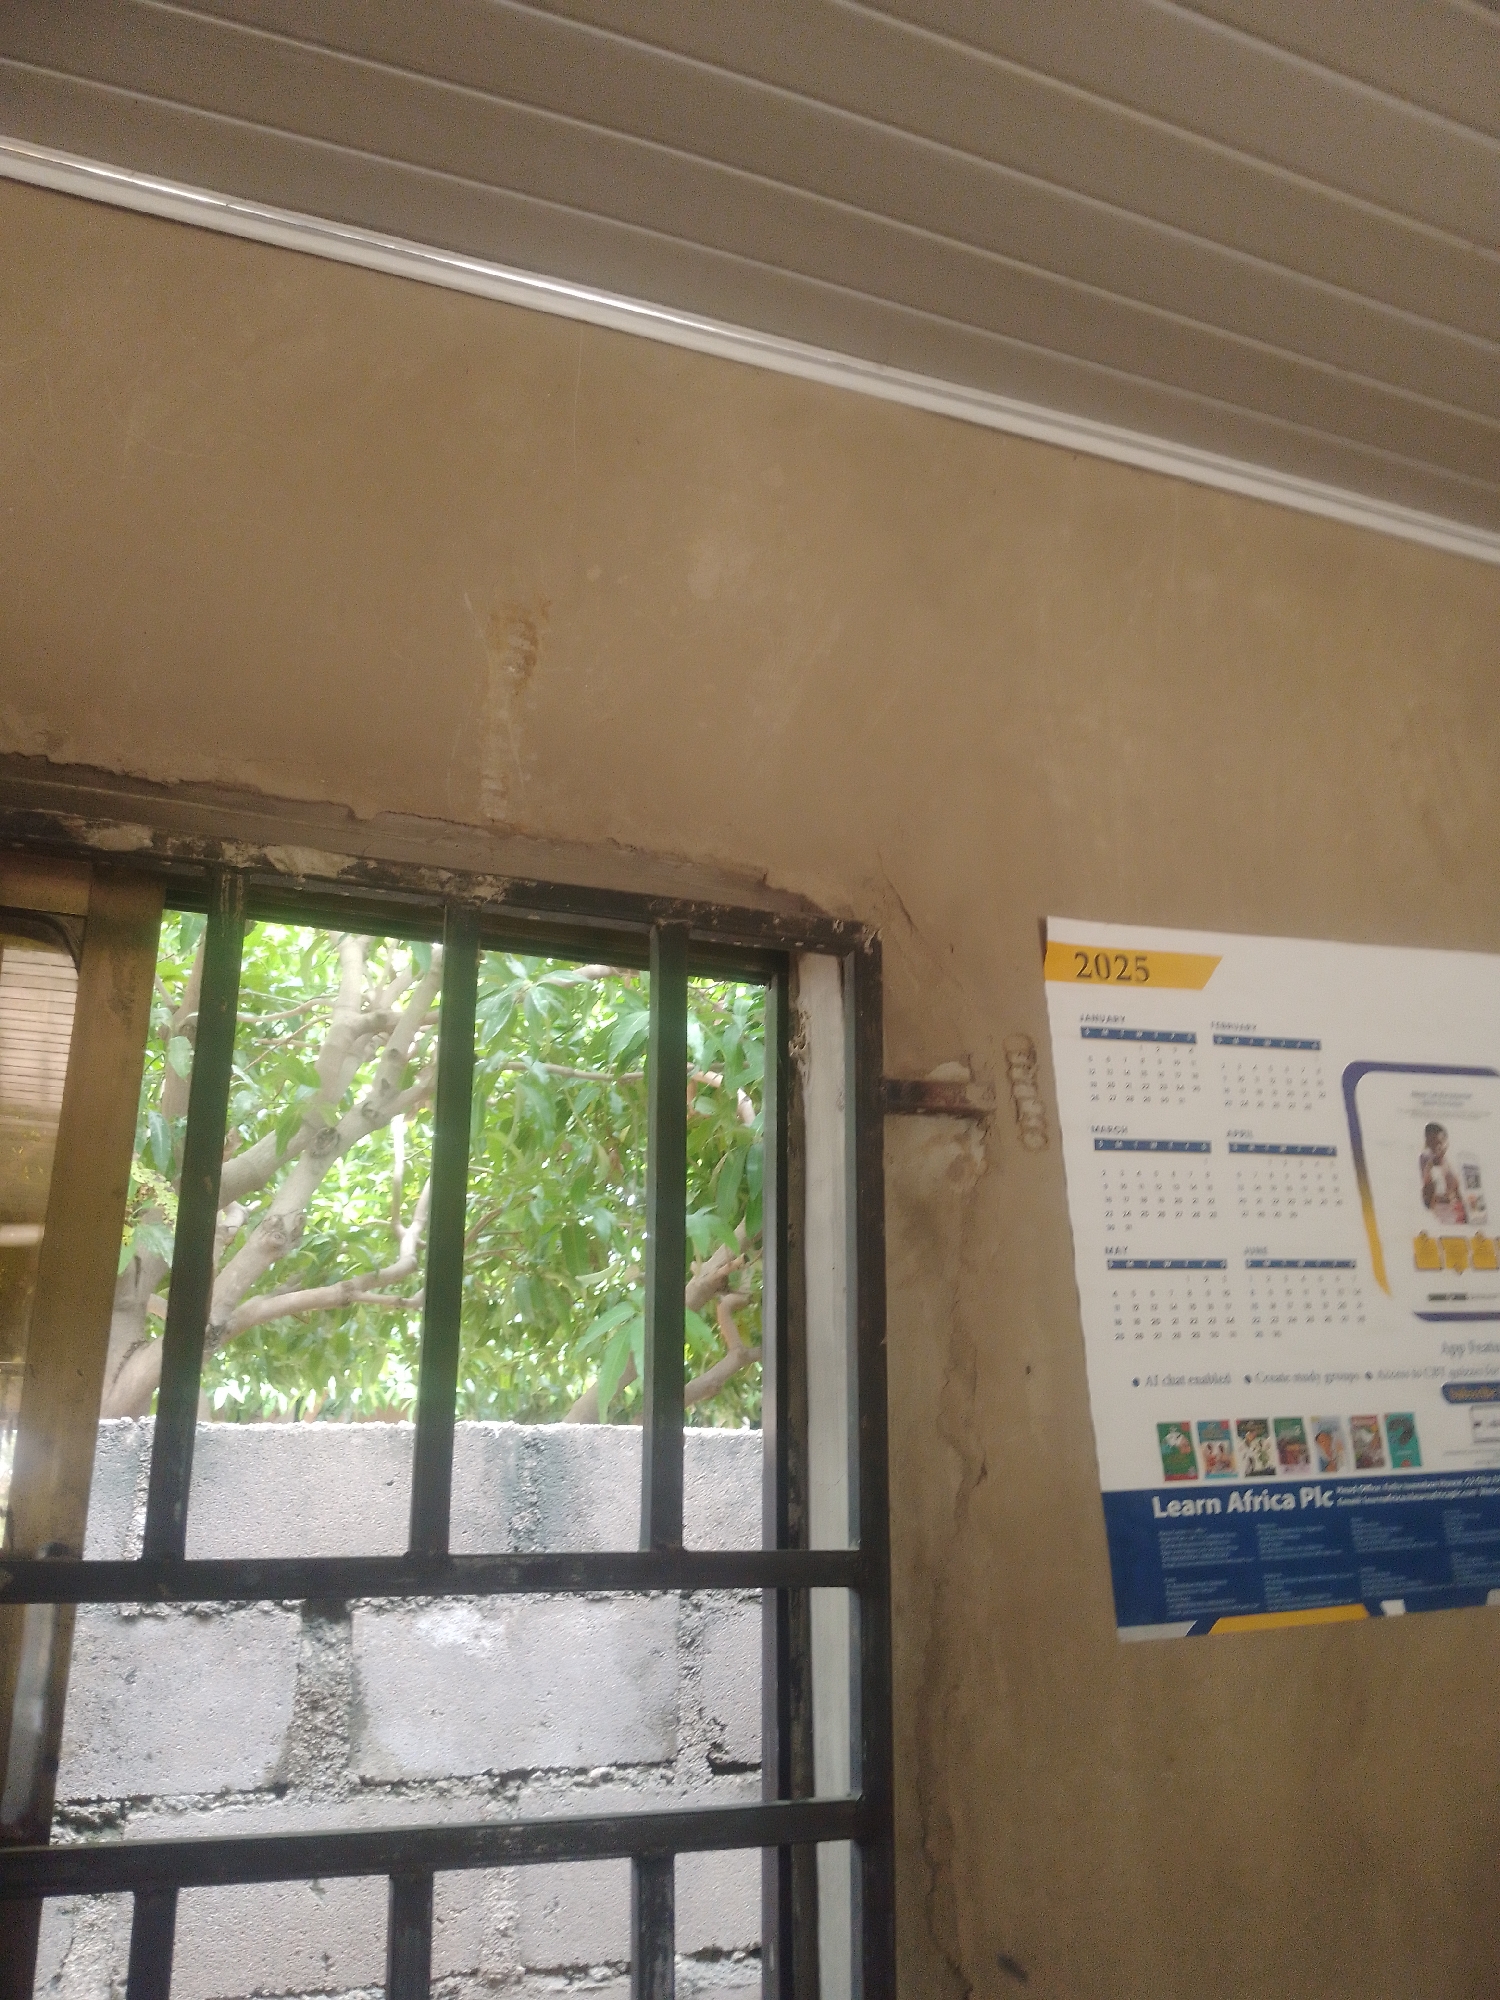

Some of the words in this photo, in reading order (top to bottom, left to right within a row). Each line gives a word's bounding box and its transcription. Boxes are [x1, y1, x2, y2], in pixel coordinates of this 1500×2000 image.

[1074, 951, 1150, 982] 2025
[1080, 1013, 1125, 1024] JANUARY
[1091, 1125, 1128, 1135] MARCH
[1105, 1246, 1128, 1256] MAY
[1162, 1374, 1185, 1387] chat
[1188, 1372, 1231, 1386] enabled
[1324, 1372, 1359, 1384] groups
[1151, 1495, 1222, 1519] Learn
[1226, 1488, 1296, 1514] Africa
[1299, 1485, 1334, 1508] Plc
